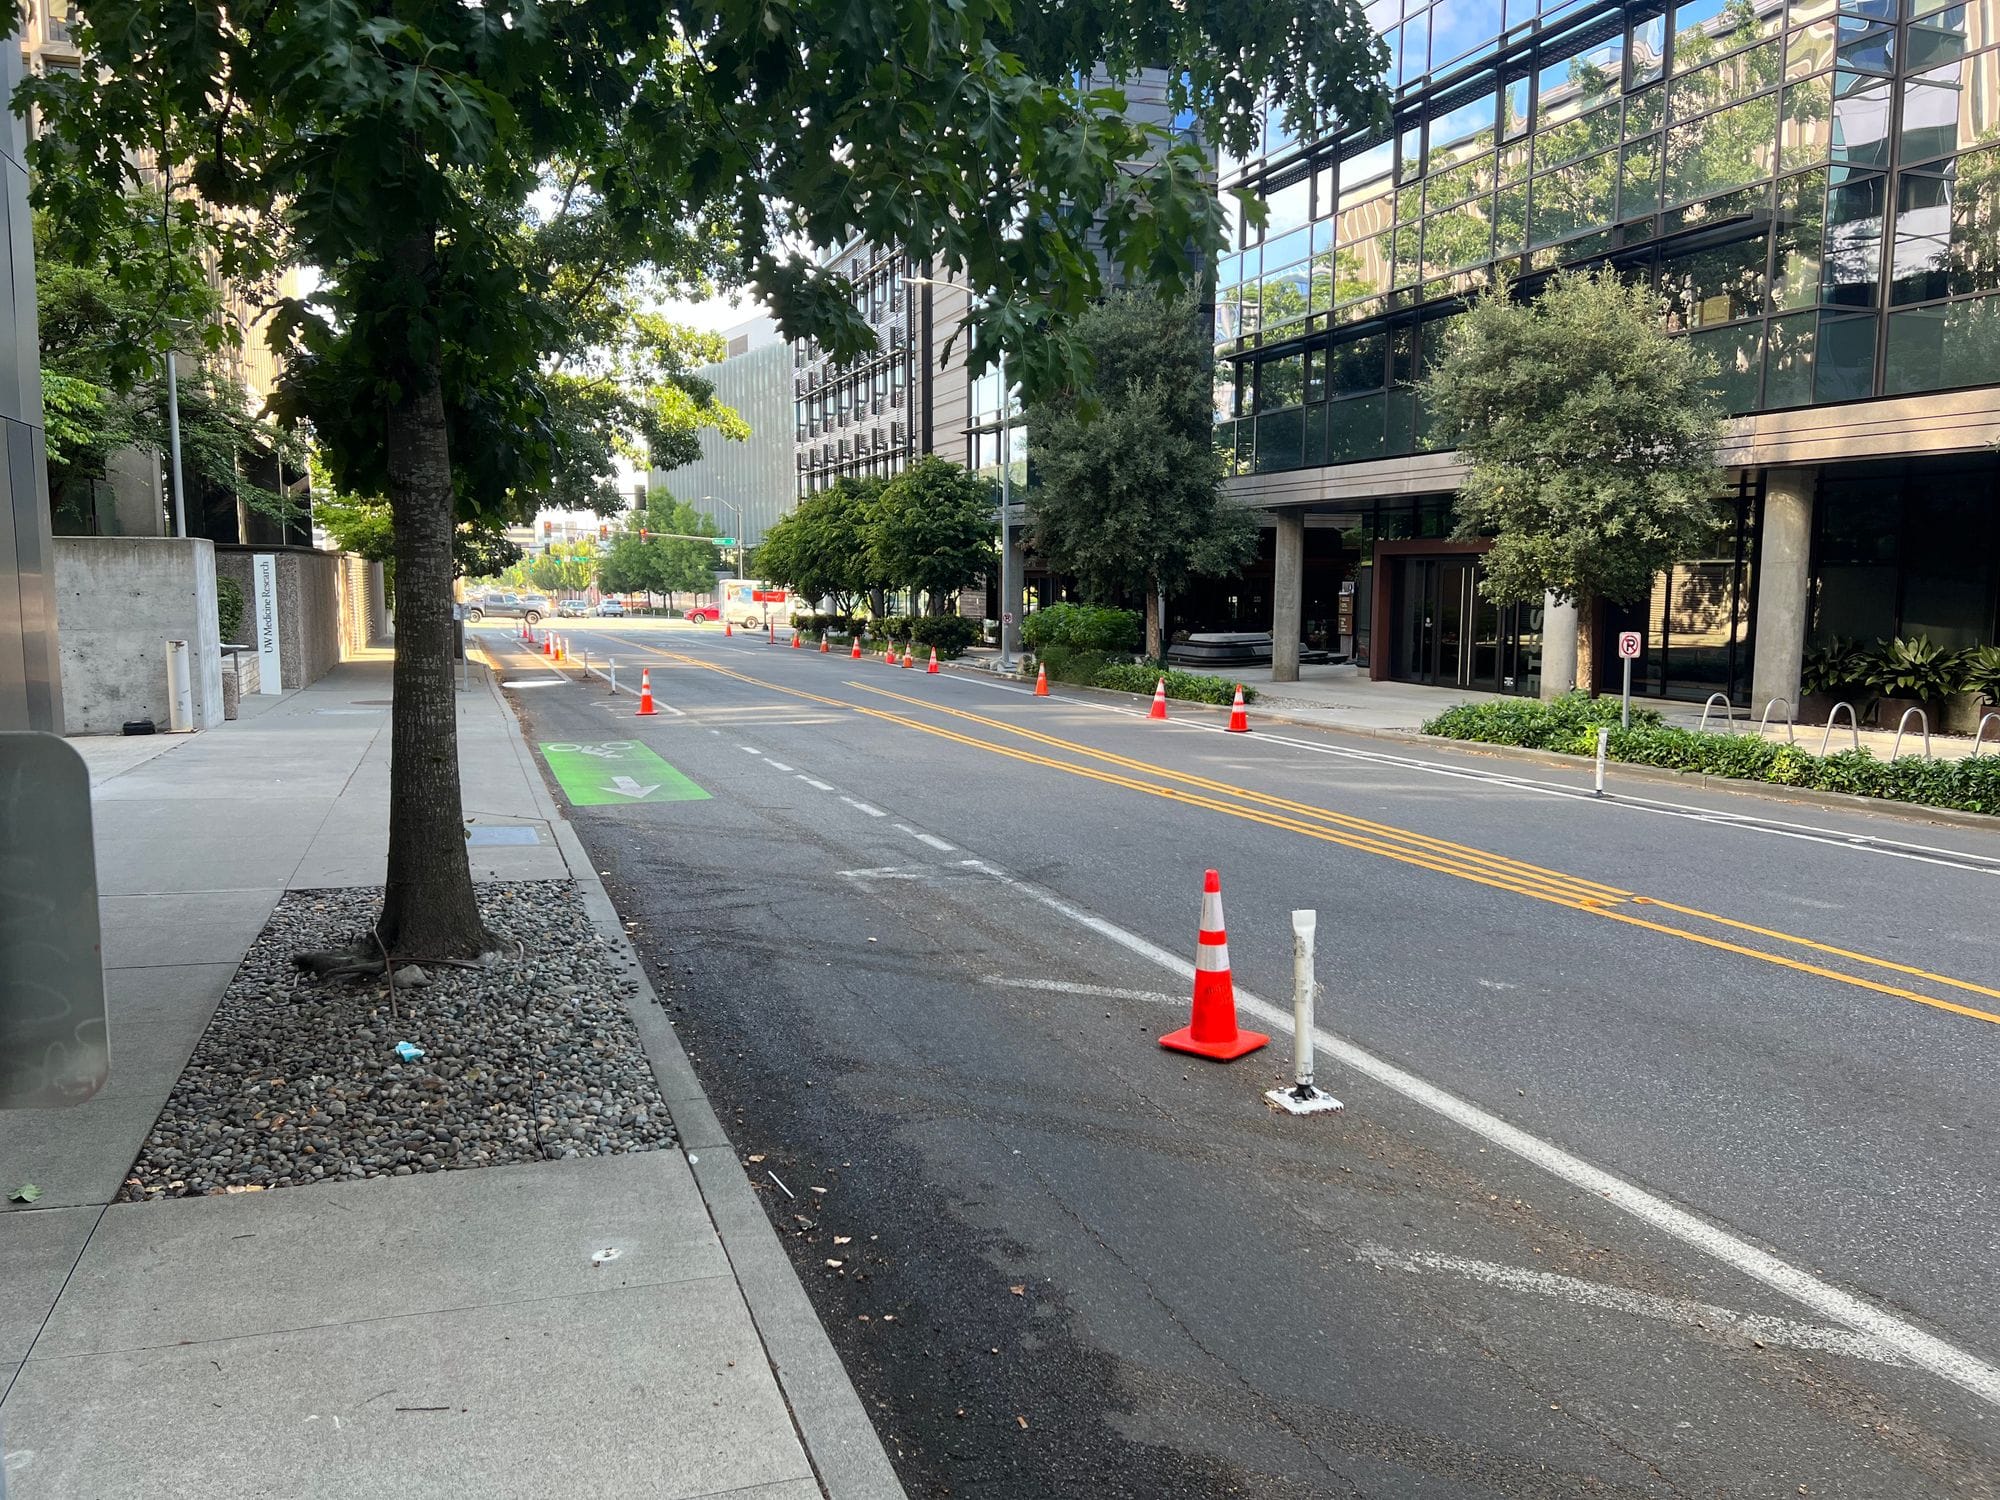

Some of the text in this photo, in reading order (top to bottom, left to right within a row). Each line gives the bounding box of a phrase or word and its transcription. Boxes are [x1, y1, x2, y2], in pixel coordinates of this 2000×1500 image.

[260, 561, 273, 653] UW Medicine Research
